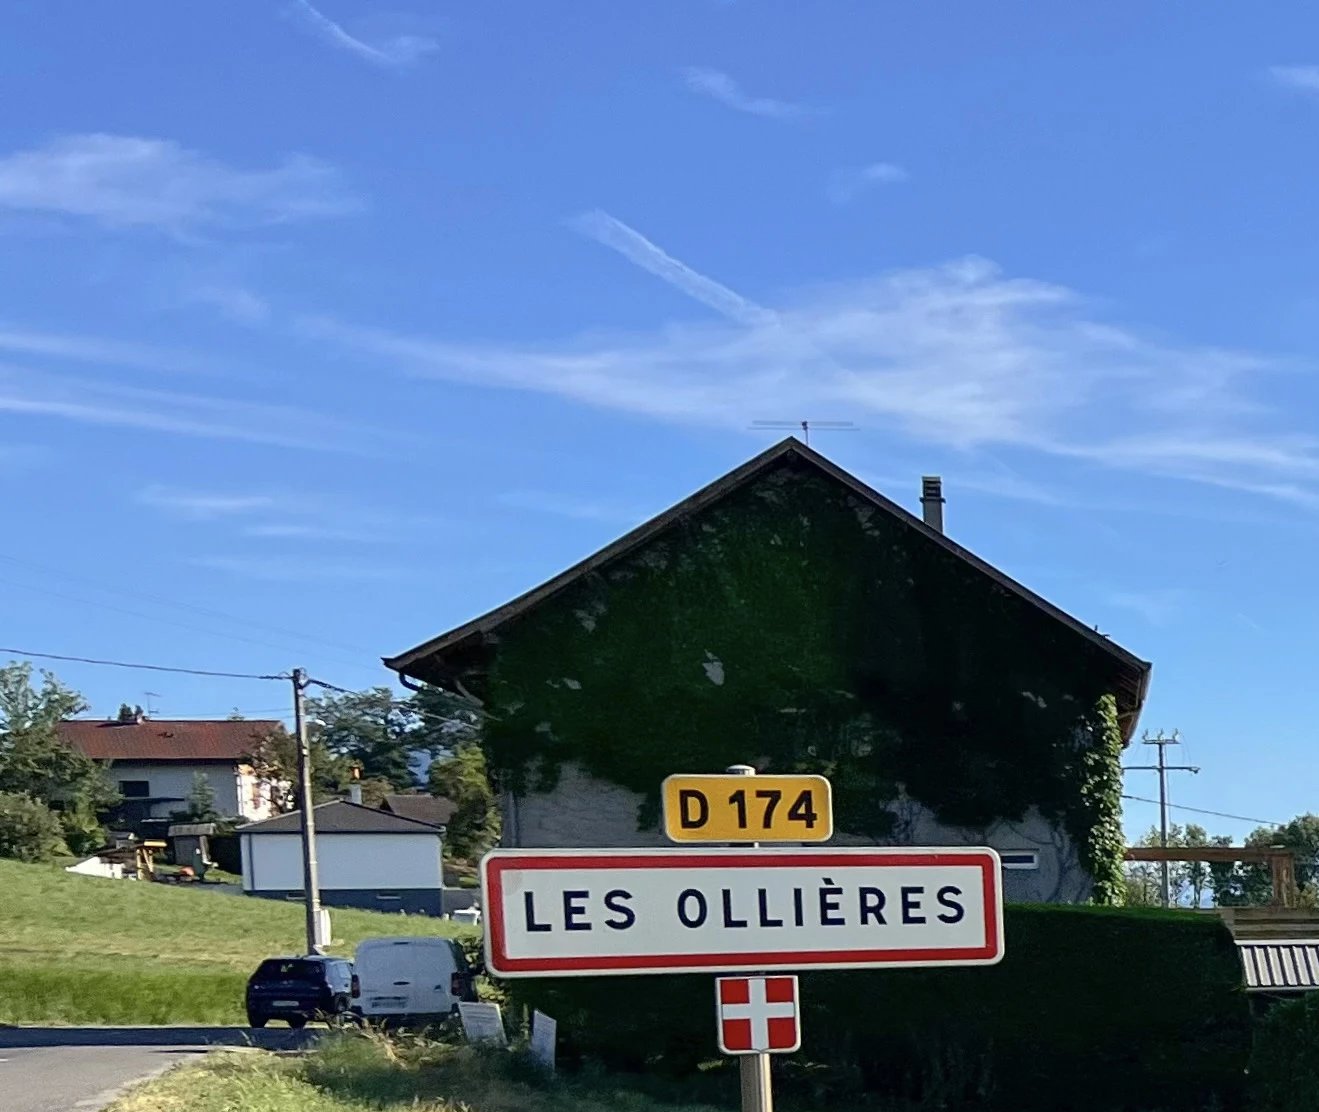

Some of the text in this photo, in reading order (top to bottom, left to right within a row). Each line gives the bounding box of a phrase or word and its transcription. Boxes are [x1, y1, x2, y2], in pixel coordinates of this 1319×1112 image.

[679, 789, 818, 829] D 174
[523, 877, 965, 932] LES OLLIÈRES
